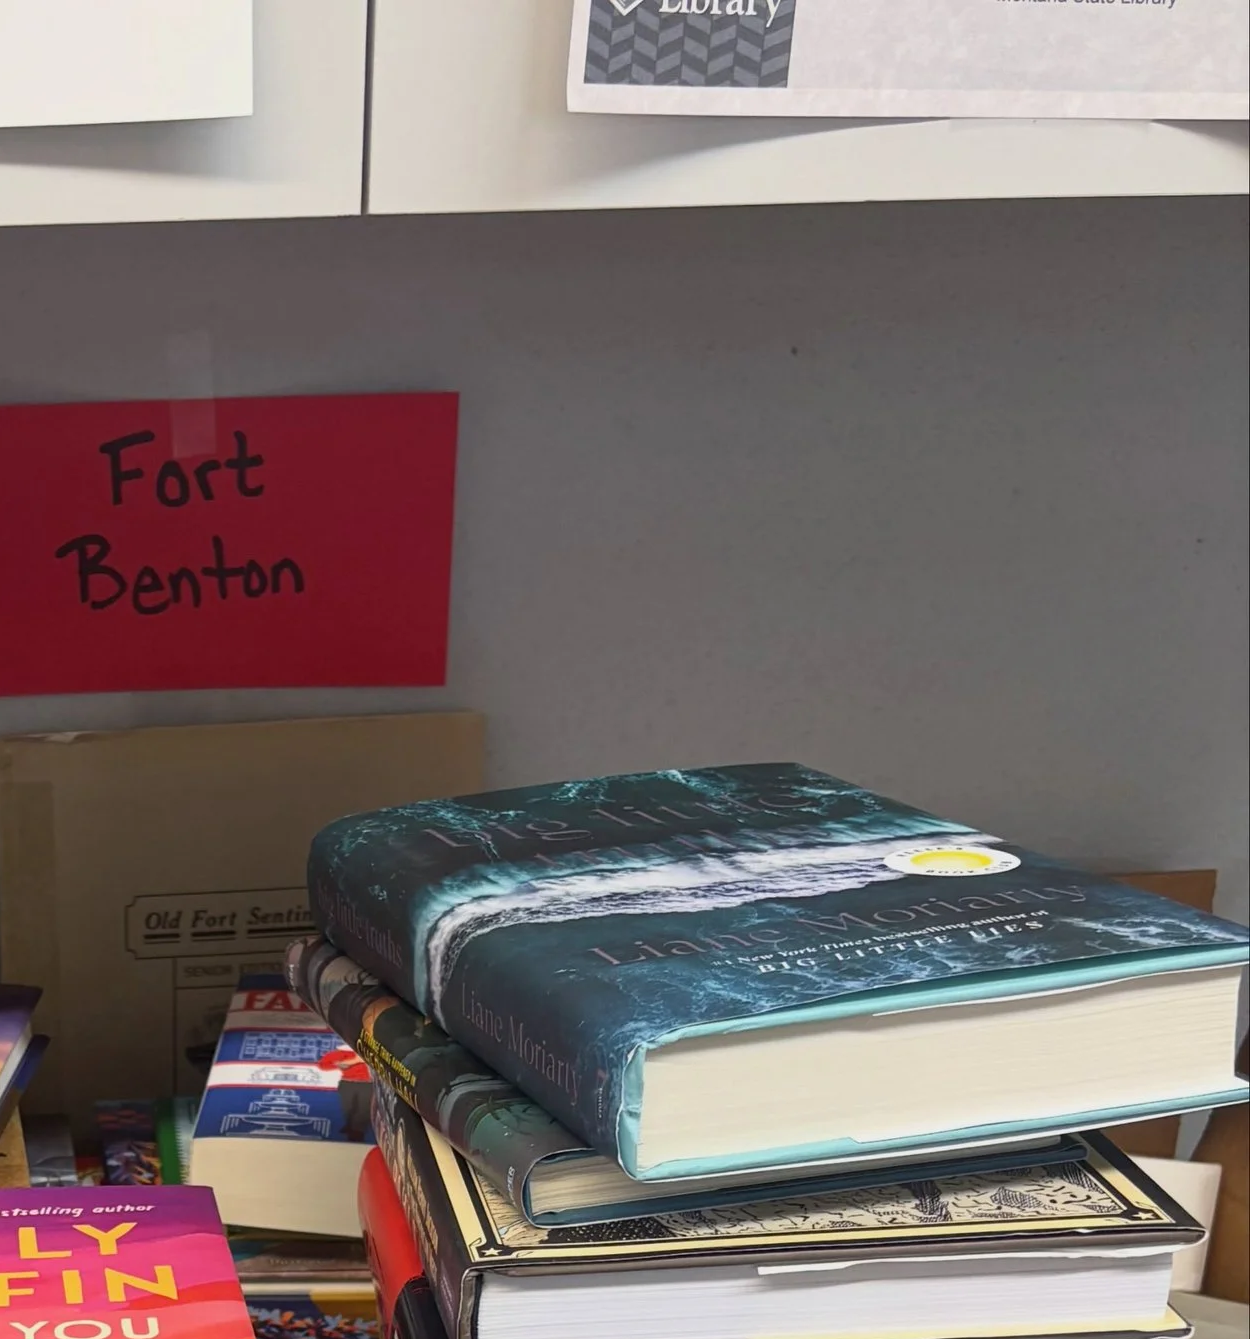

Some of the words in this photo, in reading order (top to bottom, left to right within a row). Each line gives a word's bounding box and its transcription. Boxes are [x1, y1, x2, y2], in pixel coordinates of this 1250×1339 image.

[100, 430, 265, 507] Fort
[54, 533, 305, 616] Benton
[144, 911, 181, 931] Old
[191, 908, 237, 928] Fort
[247, 904, 311, 925] Sentin
[588, 928, 788, 966] Liane
[794, 885, 1087, 937] Moriarty
[735, 953, 775, 963] New
[776, 947, 818, 958] York
[818, 939, 871, 951] Times
[970, 913, 1030, 927] author
[756, 957, 820, 975] BIG
[833, 936, 956, 962] LITTLE
[968, 920, 1047, 940] LIES
[461, 982, 503, 1043] Liane
[509, 1016, 578, 1106] Moriarty
[91, 1203, 155, 1214] author
